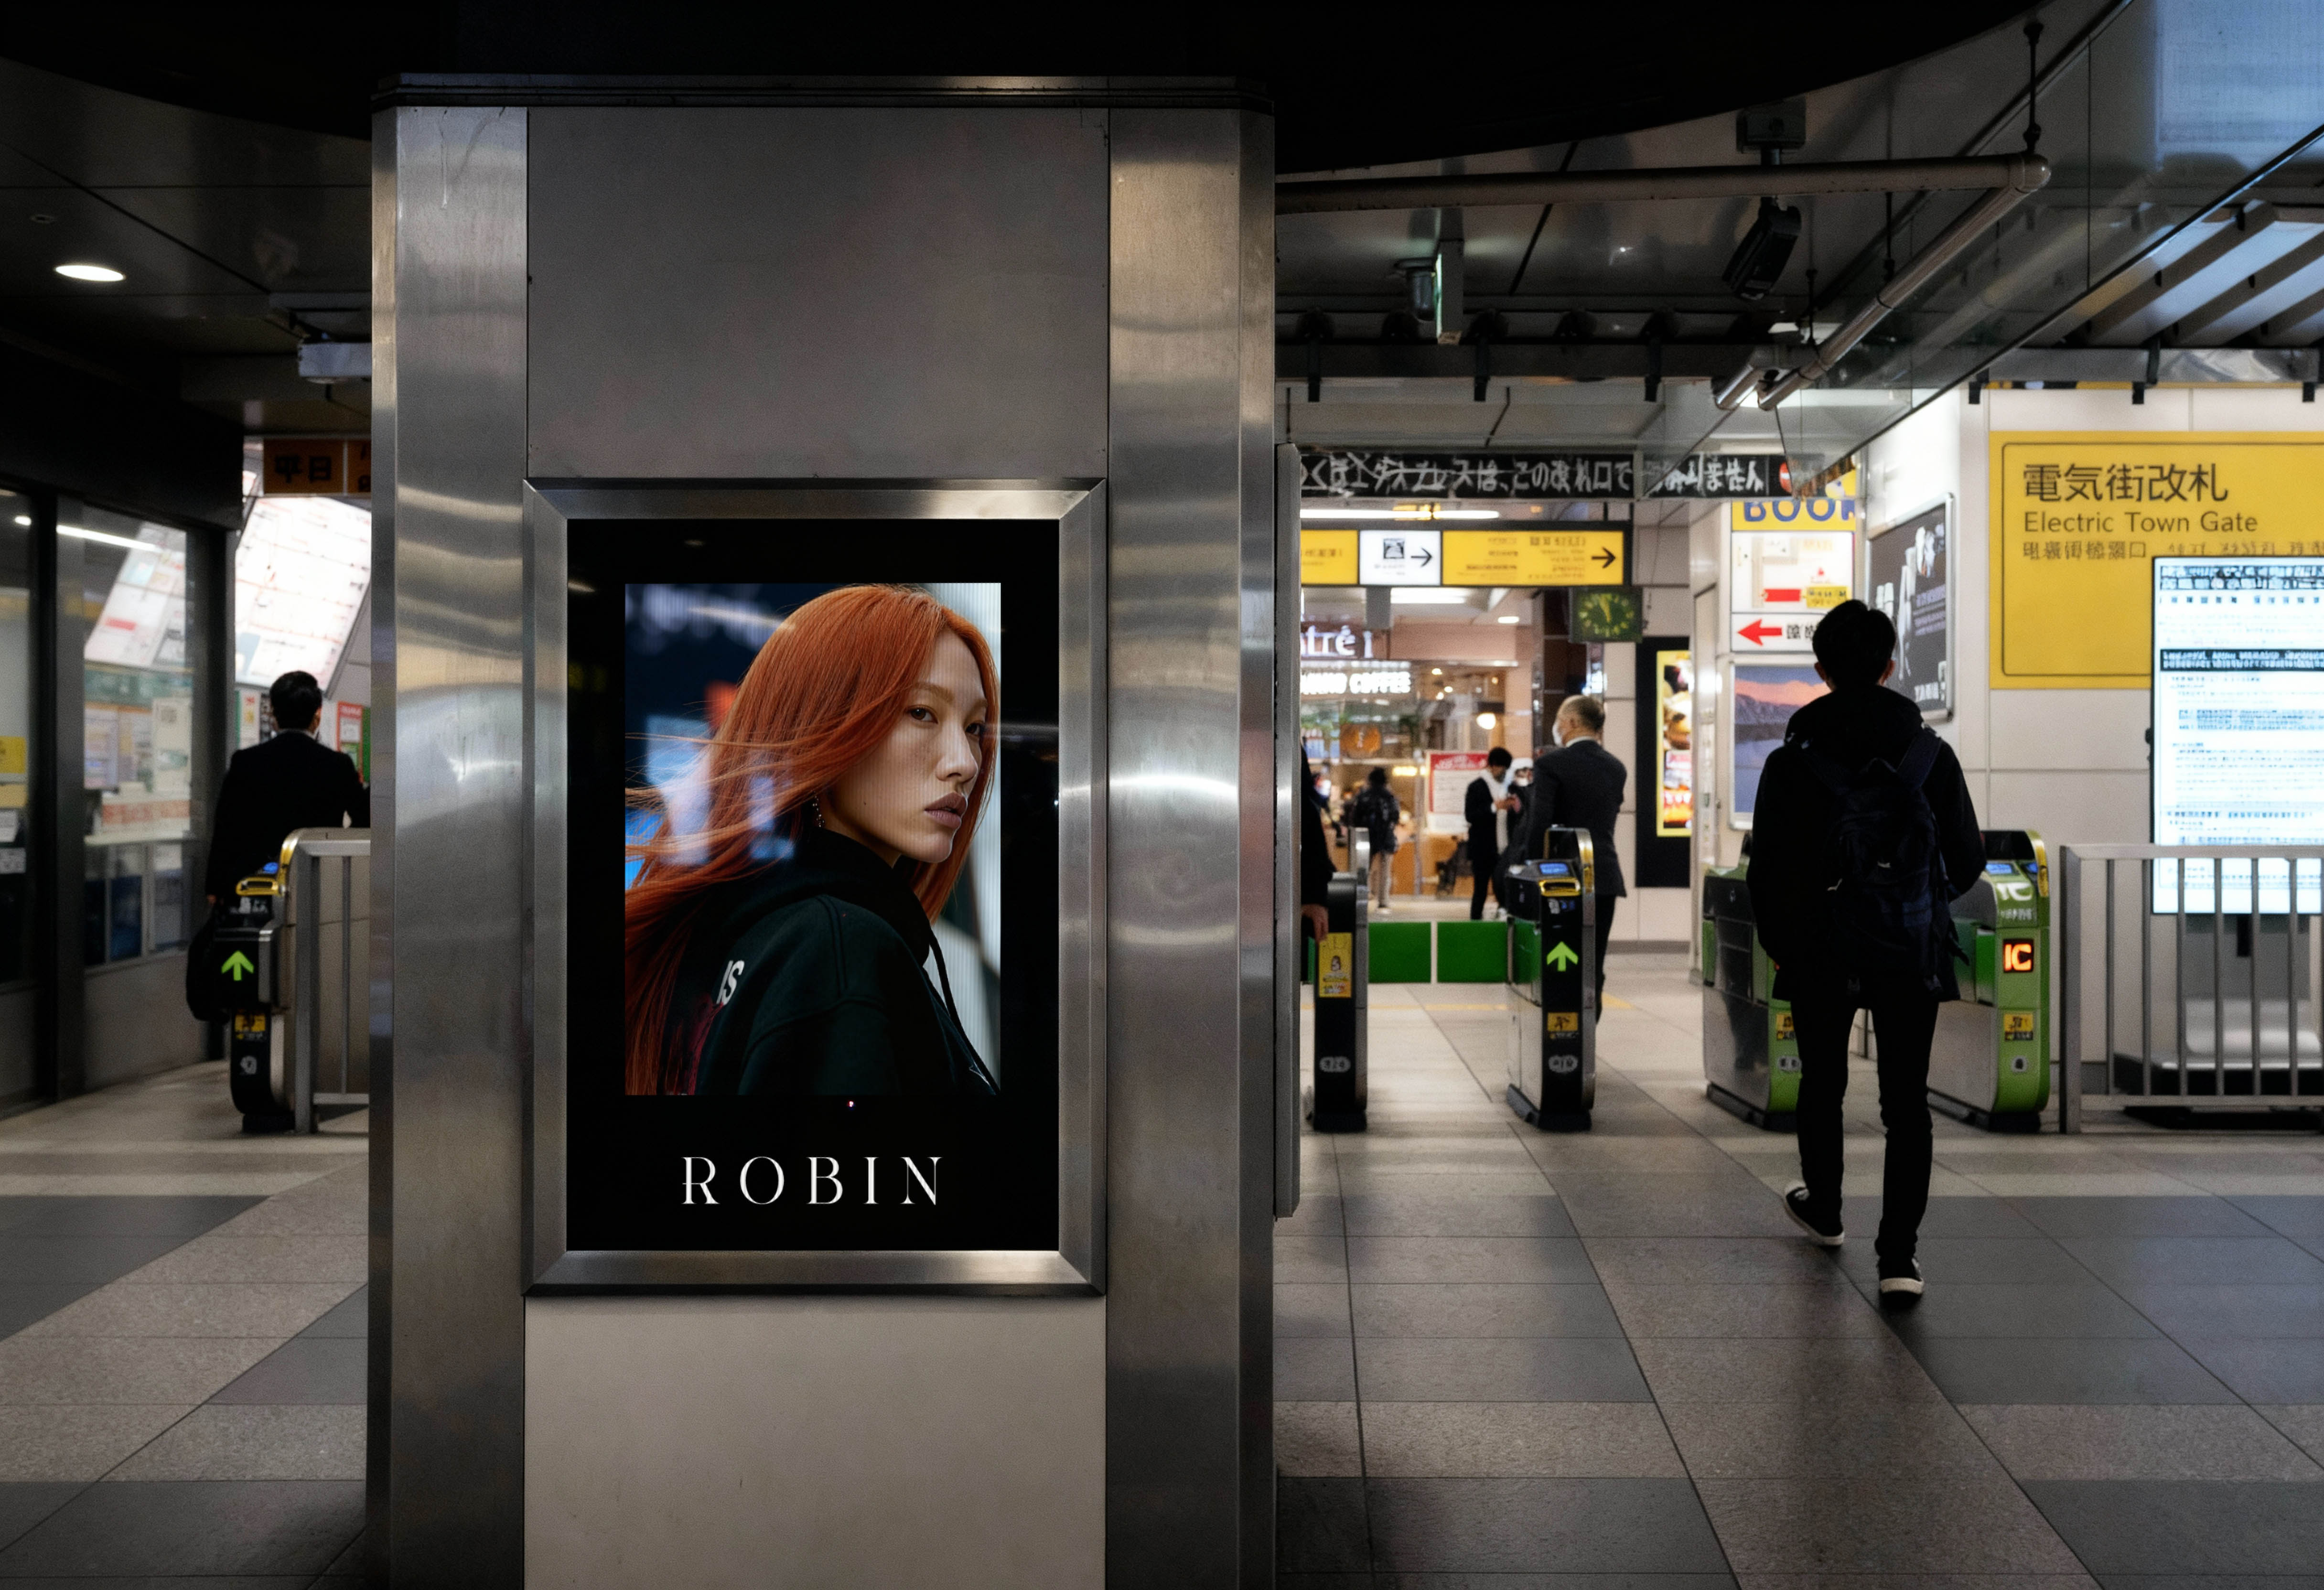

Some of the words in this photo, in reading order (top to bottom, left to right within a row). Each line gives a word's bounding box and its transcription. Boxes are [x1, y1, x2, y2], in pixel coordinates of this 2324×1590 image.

[2023, 463, 2228, 502] 電気街改札
[2024, 511, 2114, 533] Electric
[2125, 511, 2189, 533] Town
[2200, 511, 2258, 533] Gate
[1300, 625, 1356, 656] tré
[2004, 944, 2032, 971] IC
[681, 1156, 943, 1205] ROBIN
